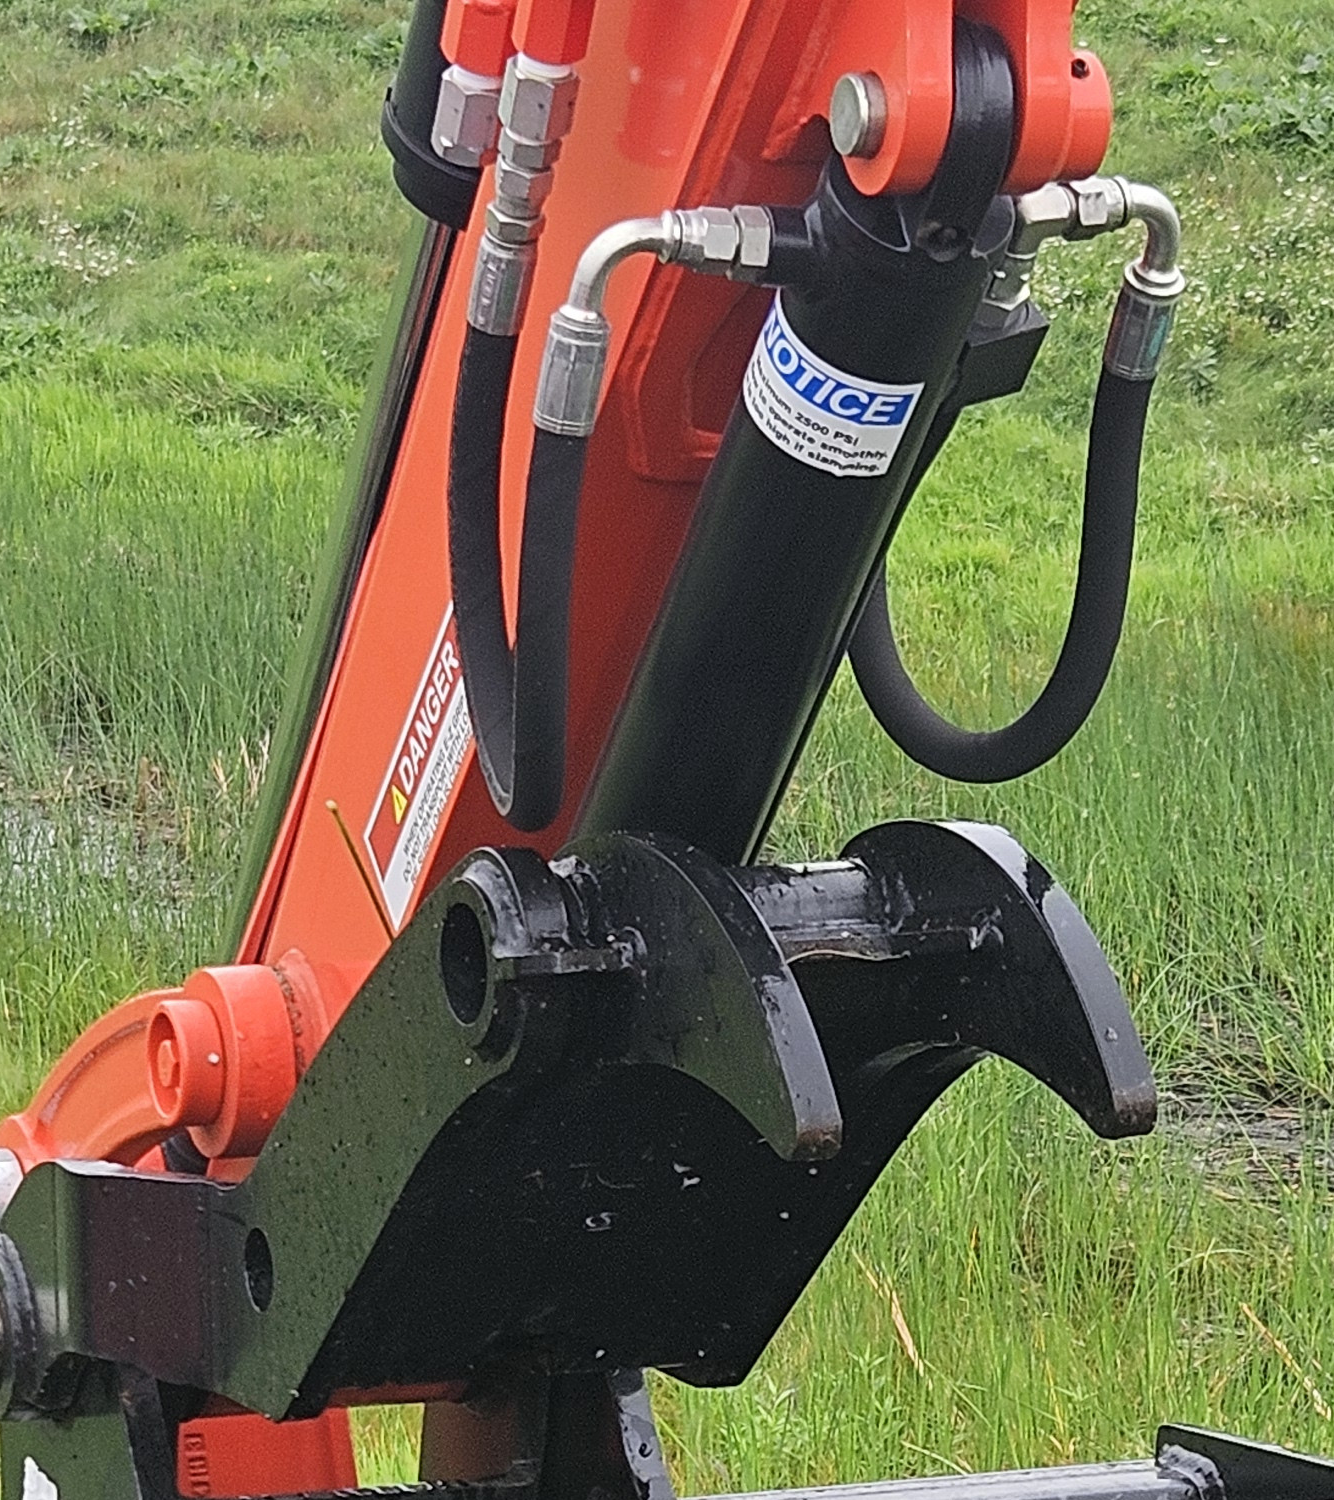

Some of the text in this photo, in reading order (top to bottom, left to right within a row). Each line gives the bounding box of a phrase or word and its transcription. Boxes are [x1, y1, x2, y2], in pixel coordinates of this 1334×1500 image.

[763, 308, 904, 423] NOTICE
[766, 418, 790, 445] high
[808, 451, 880, 472] slamming.
[769, 406, 816, 444] operate
[795, 412, 829, 435] 2500
[398, 640, 460, 796] DANGER
[410, 832, 422, 864] NOT
[419, 759, 450, 841] TRANSPORT
[417, 745, 446, 822] OPERATING
